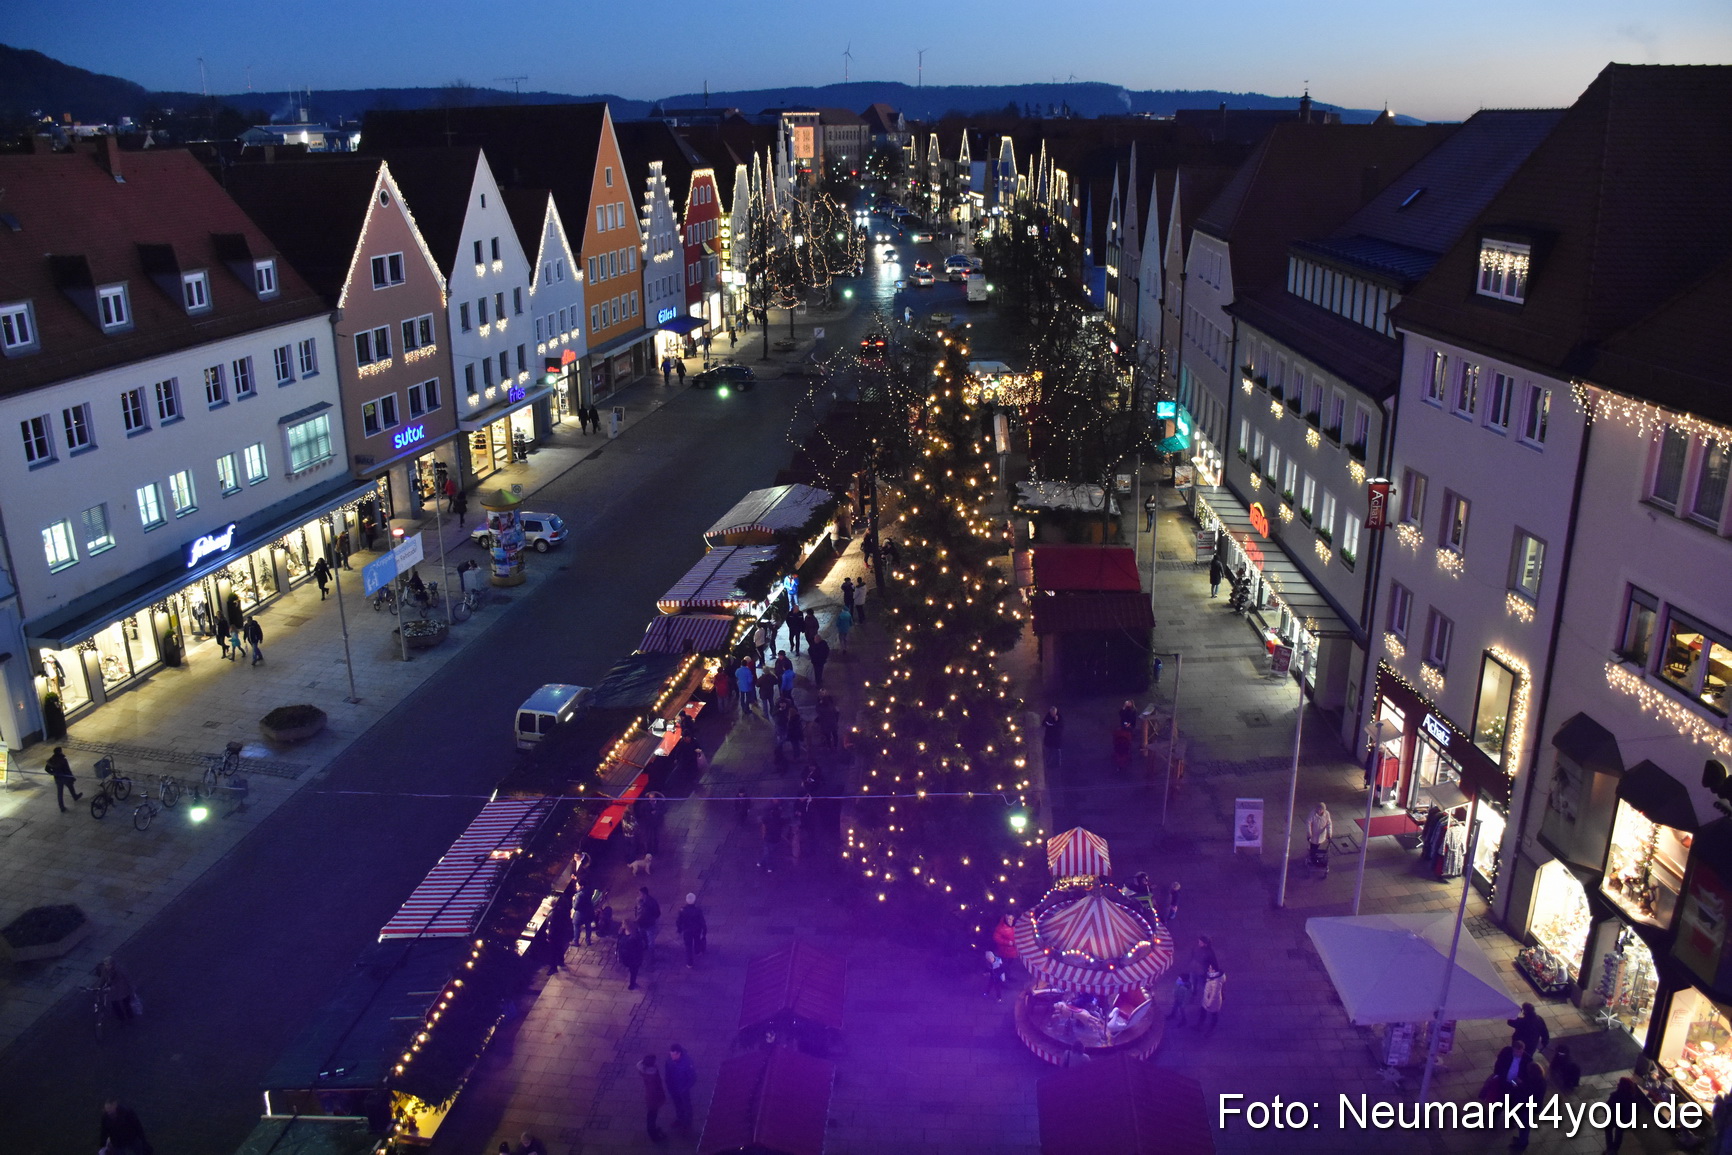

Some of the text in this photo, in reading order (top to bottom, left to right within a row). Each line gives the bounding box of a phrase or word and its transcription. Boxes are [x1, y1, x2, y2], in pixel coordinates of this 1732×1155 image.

[720, 217, 731, 271] HOTEL
[1249, 503, 1269, 539] RENO
[1370, 489, 1384, 526] Achatz
[1422, 713, 1451, 747] Achatz
